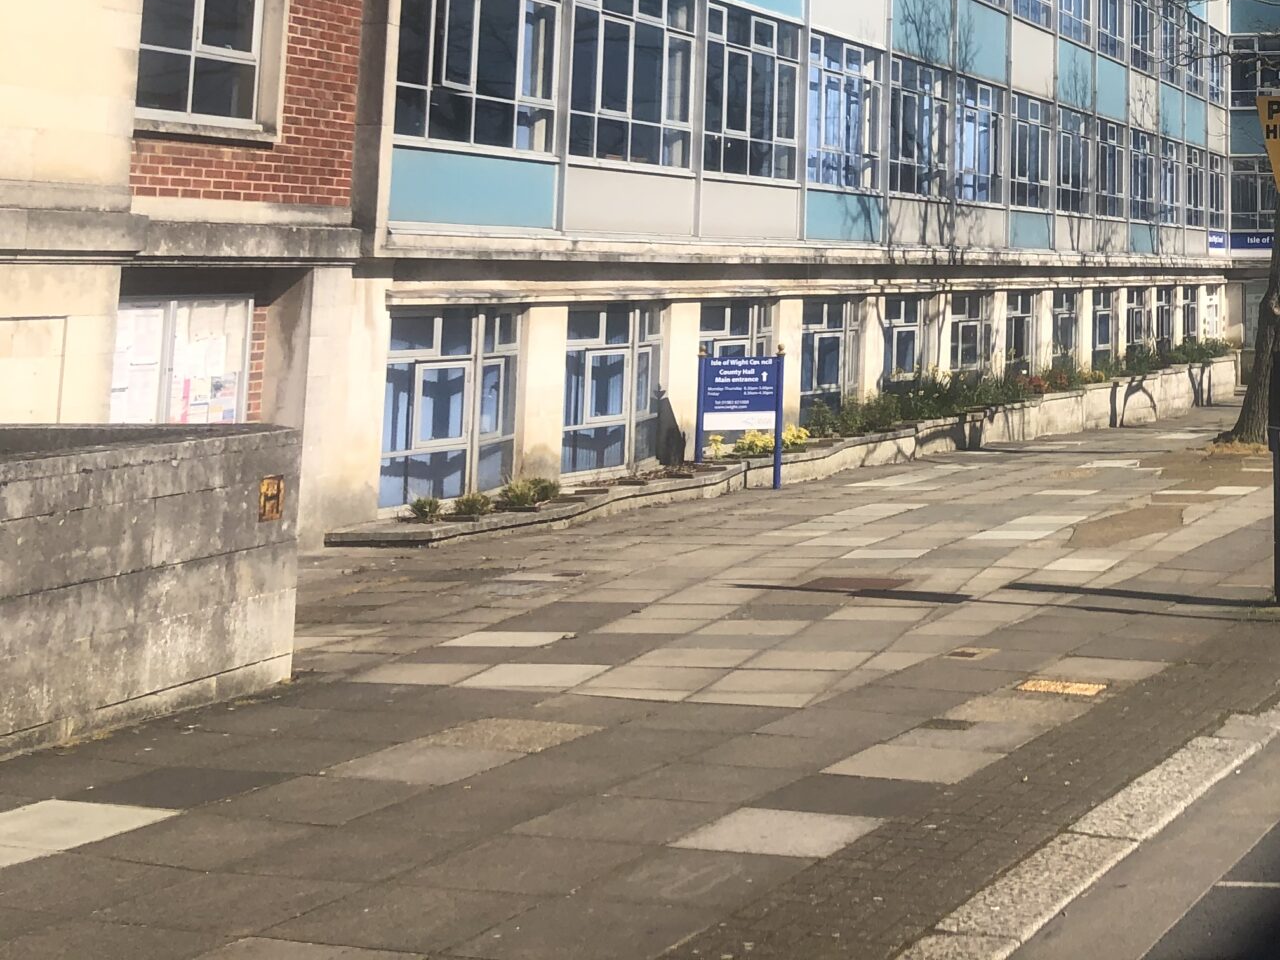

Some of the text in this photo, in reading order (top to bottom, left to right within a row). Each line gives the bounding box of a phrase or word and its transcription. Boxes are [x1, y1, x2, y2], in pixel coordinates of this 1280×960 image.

[1247, 236, 1260, 244] Isle
[1261, 236, 1270, 244] of
[730, 359, 749, 367] Wight
